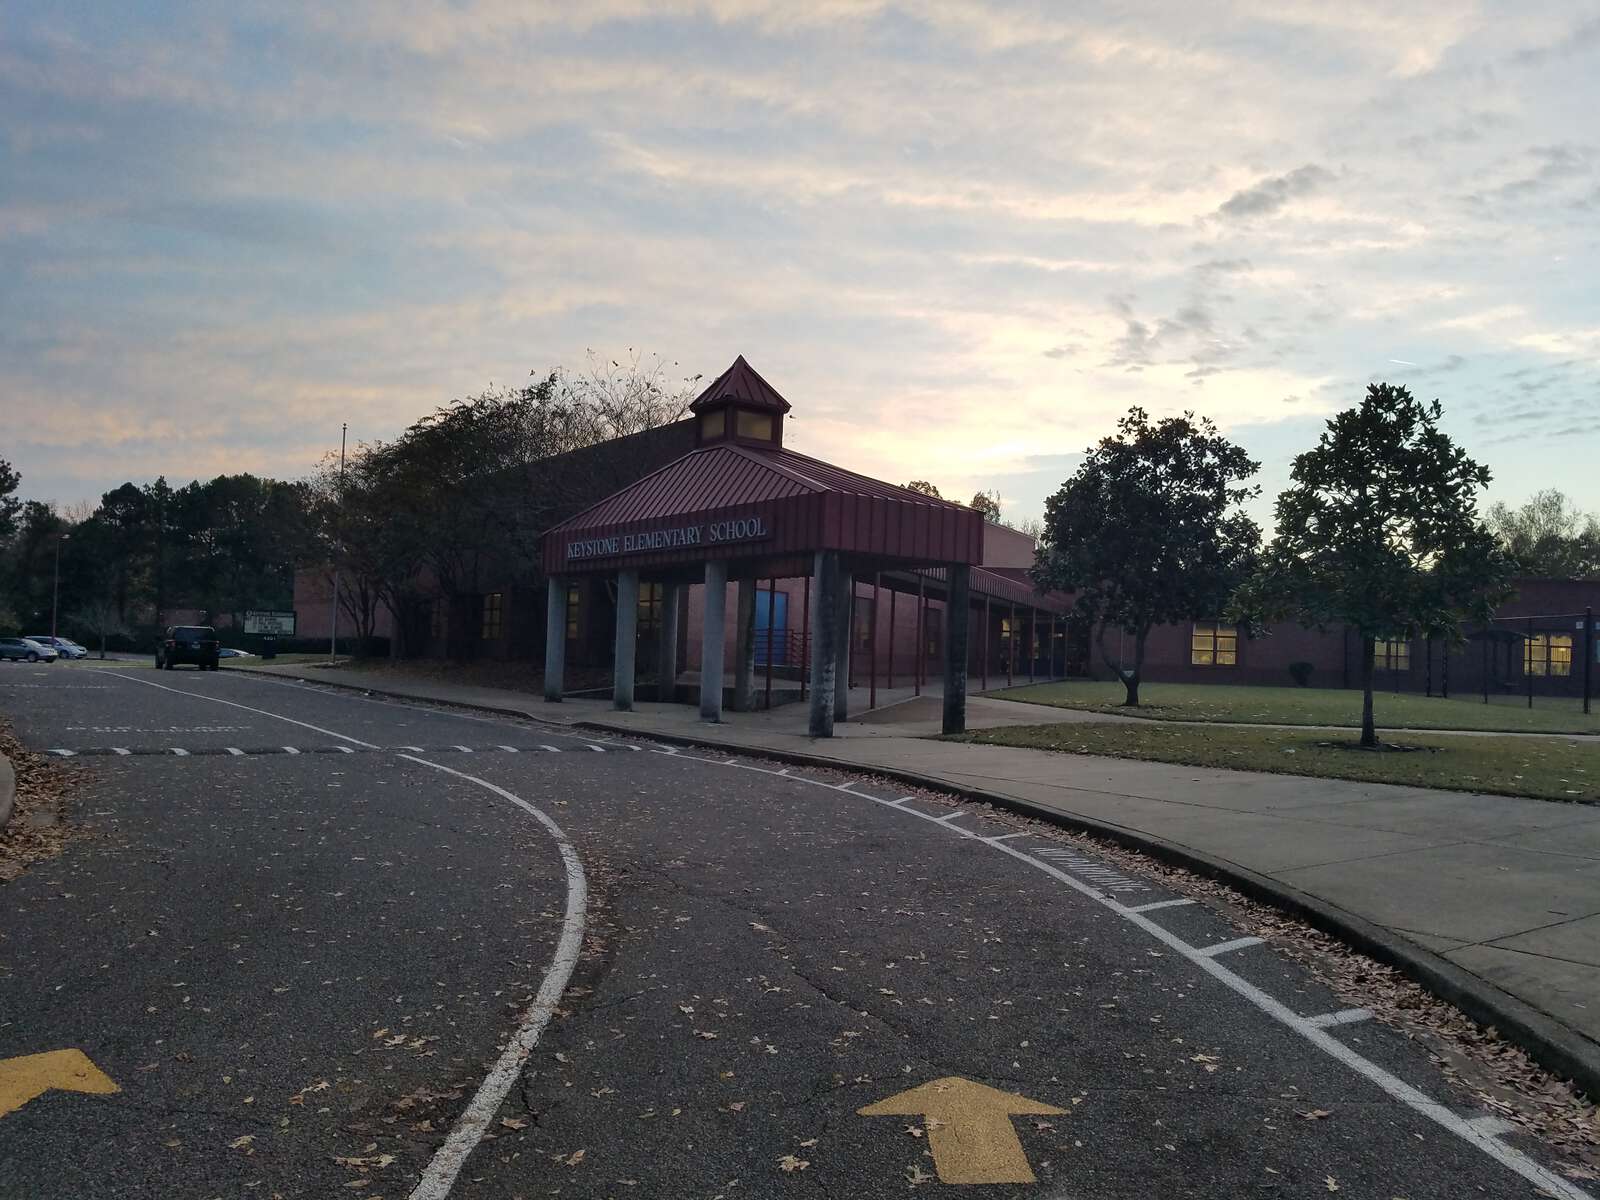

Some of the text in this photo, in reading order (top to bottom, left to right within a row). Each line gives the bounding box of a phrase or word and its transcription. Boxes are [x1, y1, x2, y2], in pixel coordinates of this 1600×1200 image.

[567, 518, 766, 559] KEYSTONE ELEMENTARY SCHOOL
